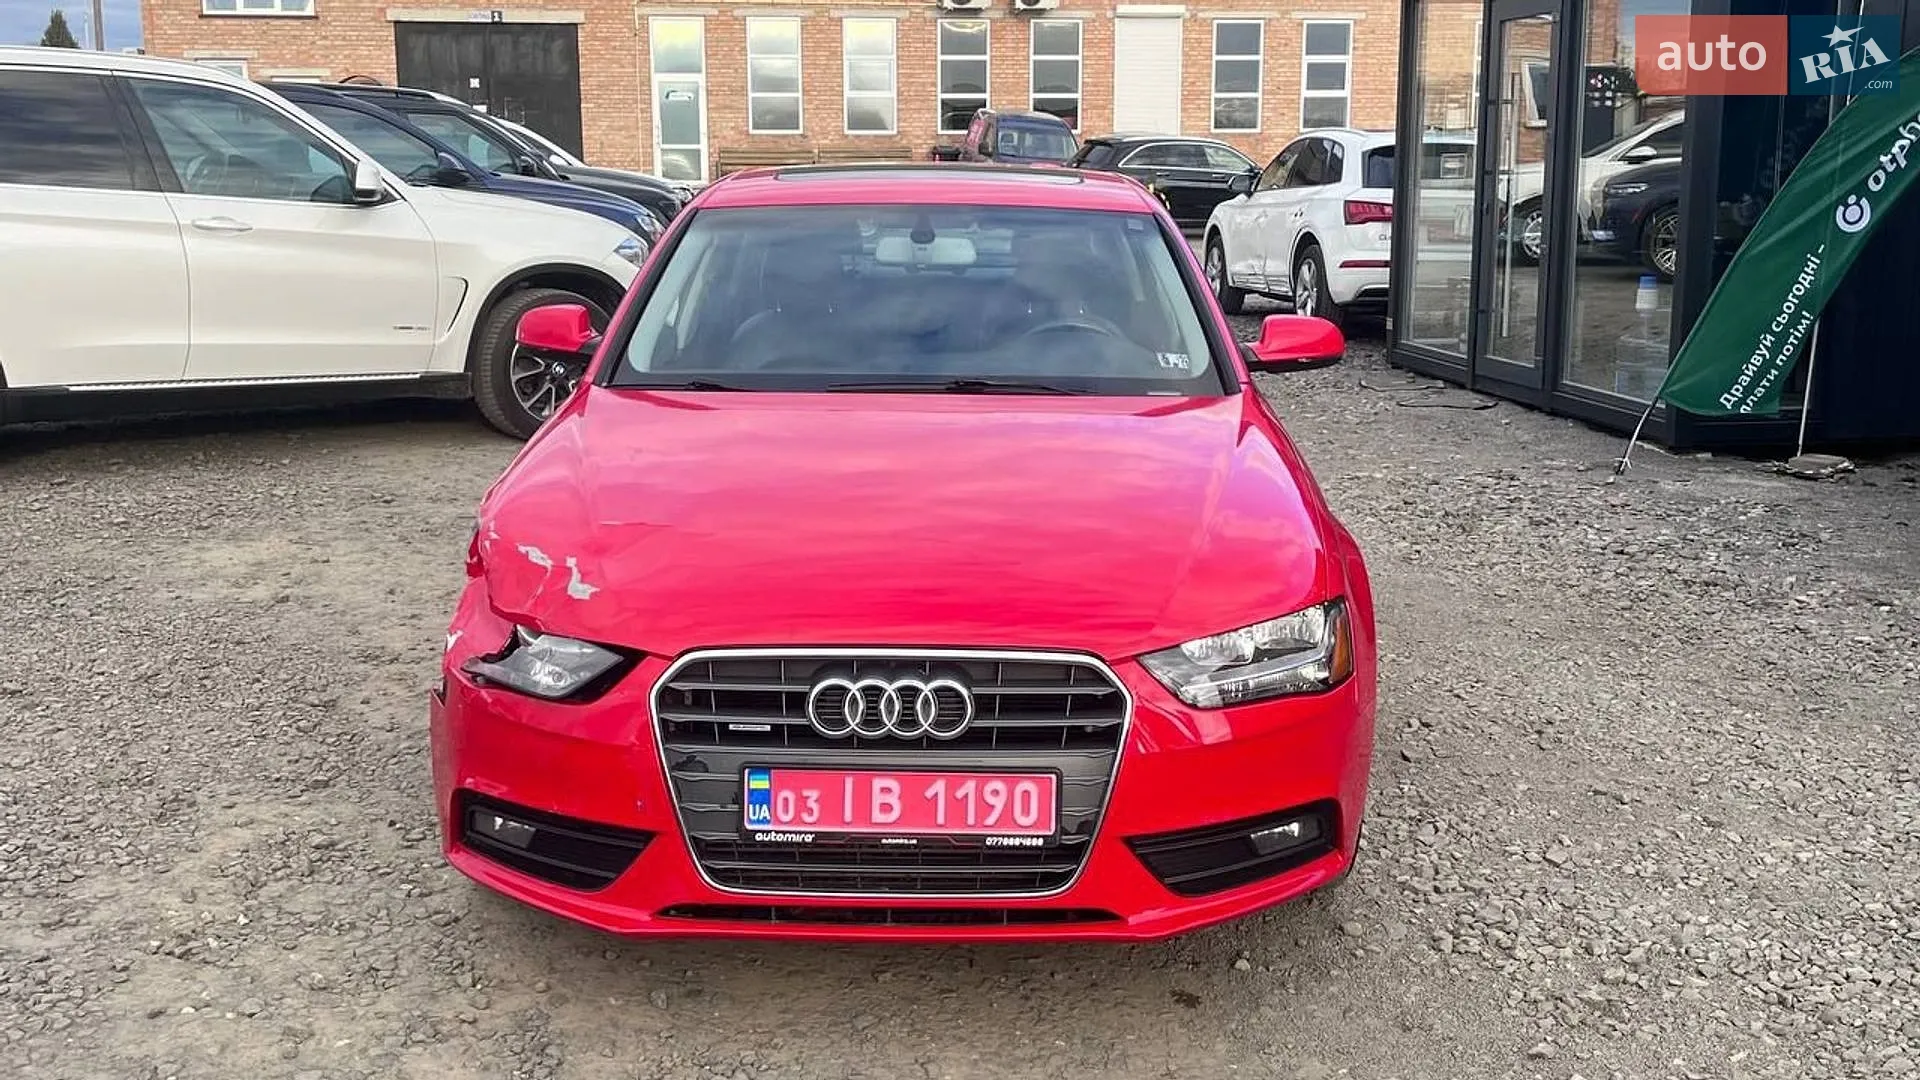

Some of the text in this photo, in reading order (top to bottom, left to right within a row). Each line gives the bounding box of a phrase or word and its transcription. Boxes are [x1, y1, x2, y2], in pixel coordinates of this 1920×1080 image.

[1719, 333, 1776, 410] Драйвуй
[1771, 253, 1821, 332] сьогодні
[1739, 310, 1814, 414] плати потім!
[748, 804, 771, 820] UA
[776, 788, 821, 824] 03
[924, 779, 1039, 827] 1190
[755, 831, 814, 842] automira
